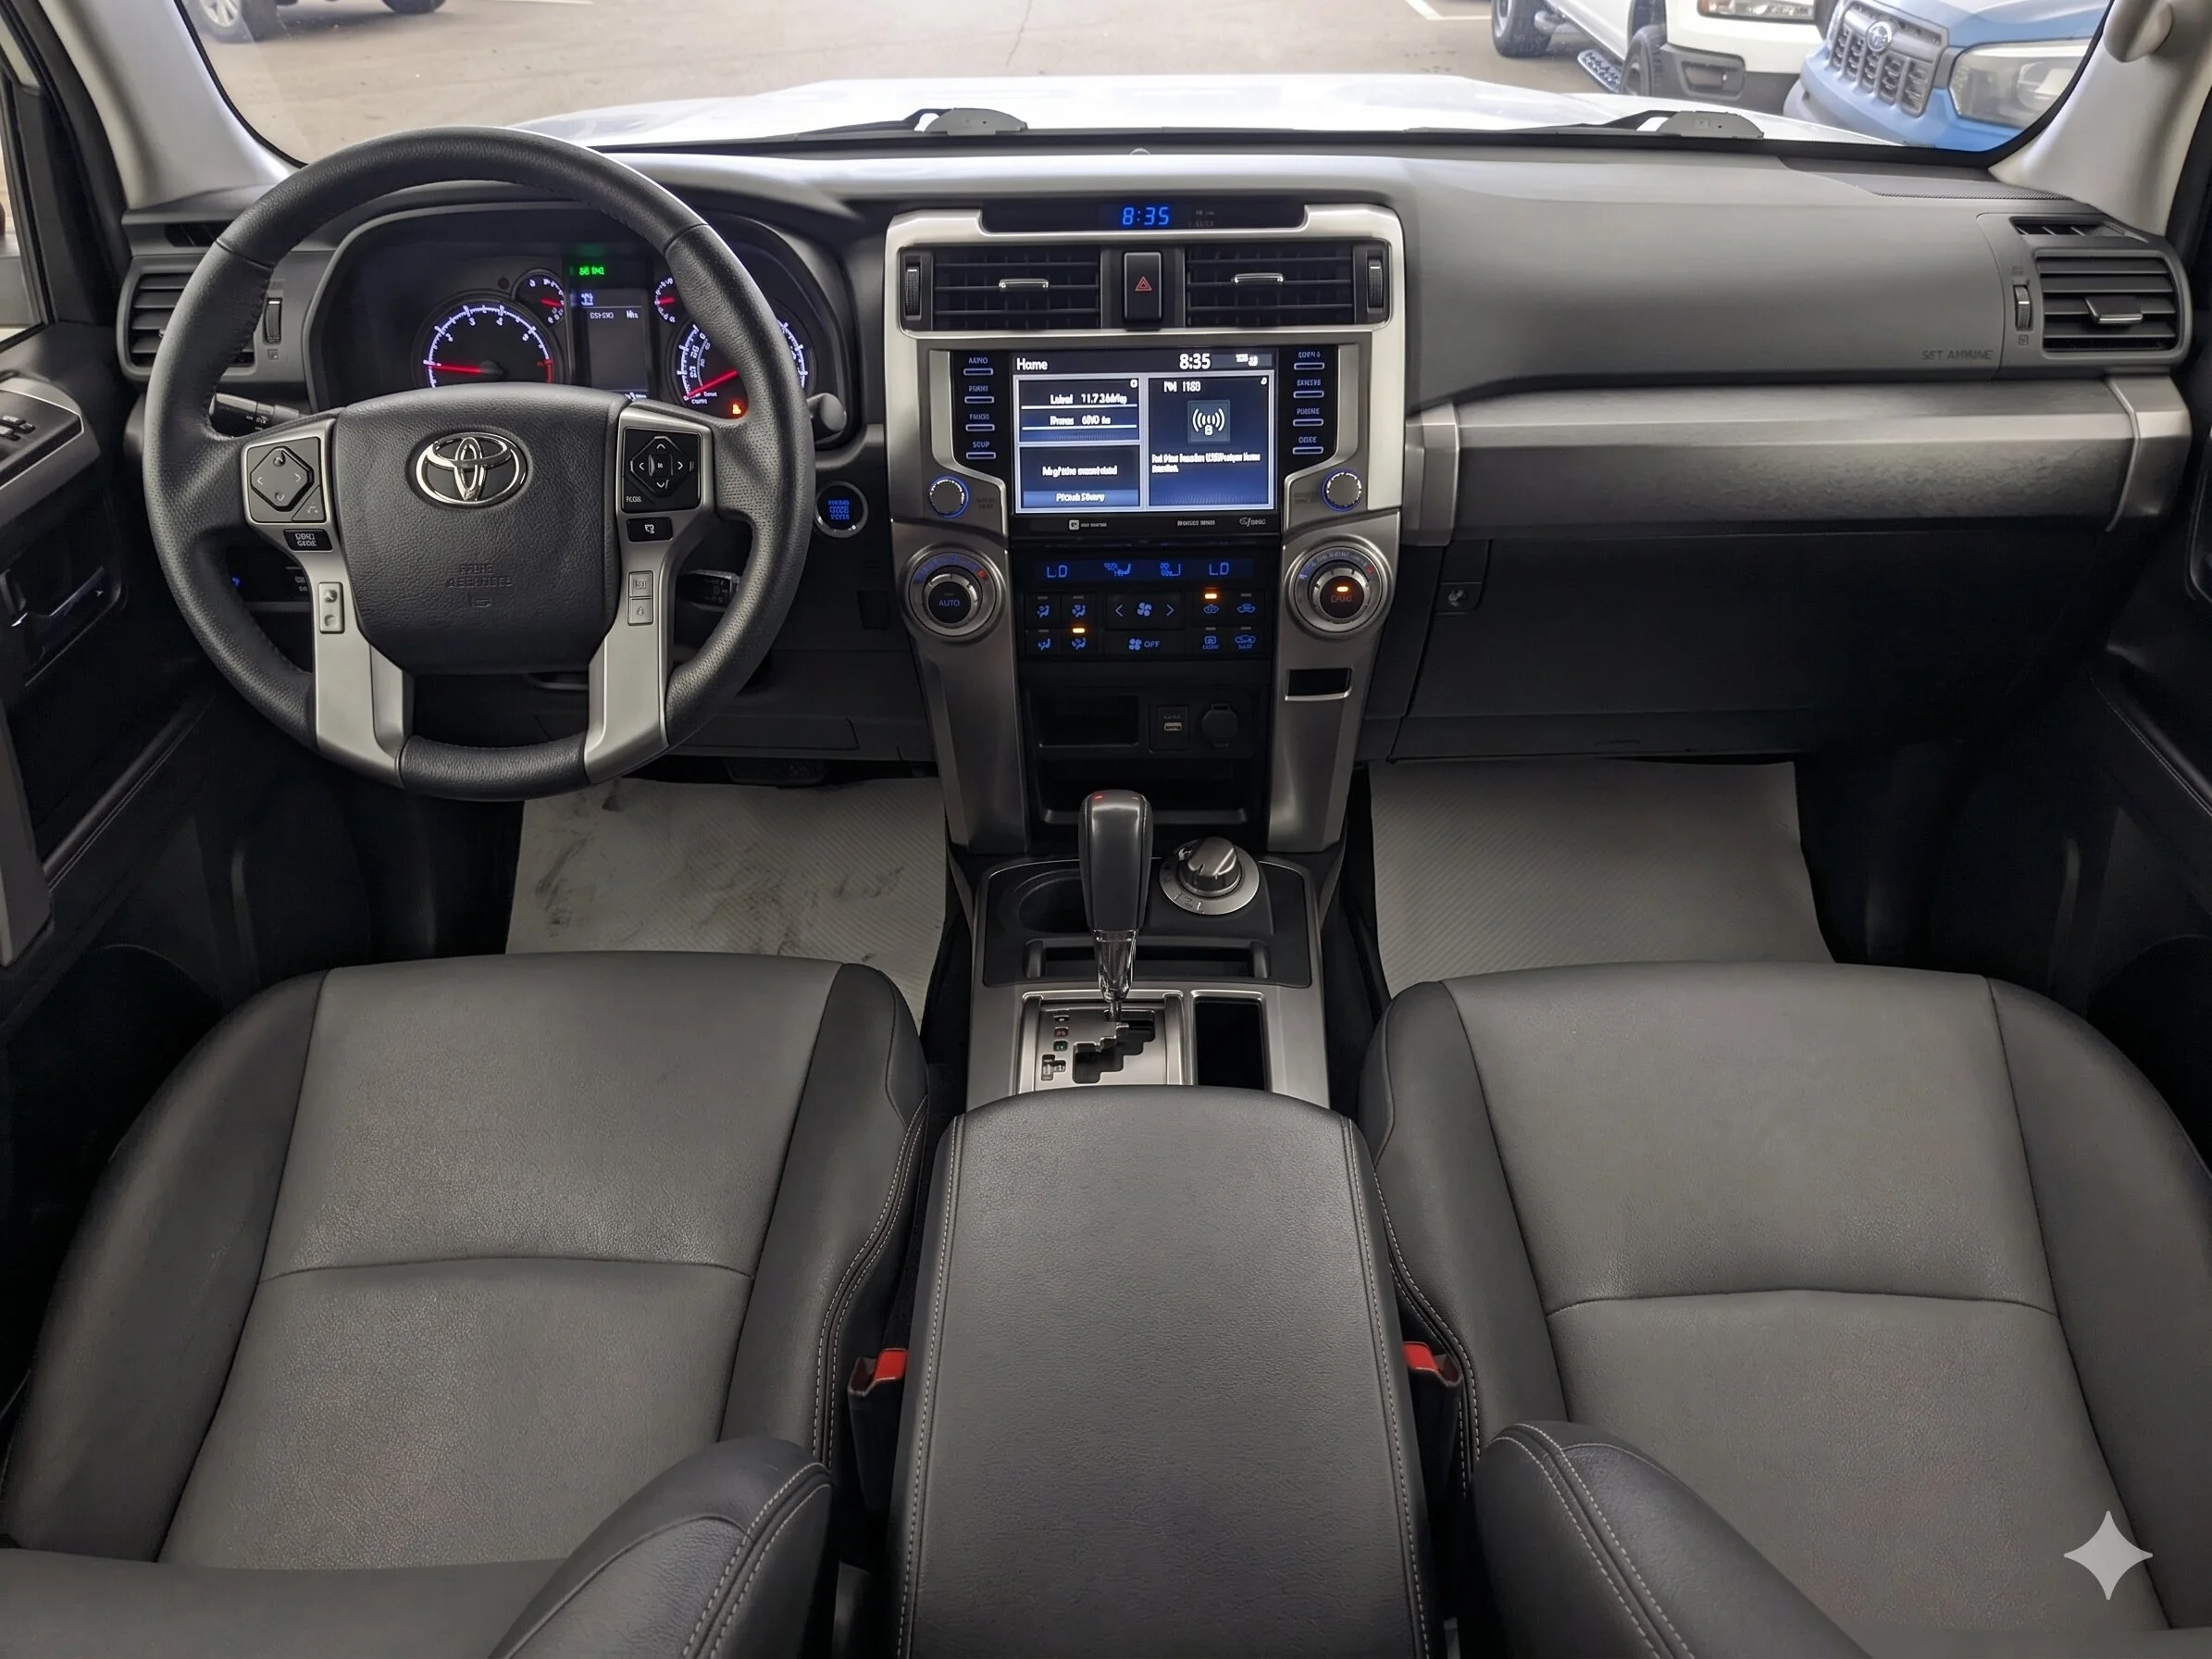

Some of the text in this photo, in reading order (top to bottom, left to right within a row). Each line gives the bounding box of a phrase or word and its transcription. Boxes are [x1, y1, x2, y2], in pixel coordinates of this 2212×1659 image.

[1123, 207, 1169, 225] 8:35
[1179, 353, 1212, 369] 8:35
[938, 599, 961, 607] AUTO
